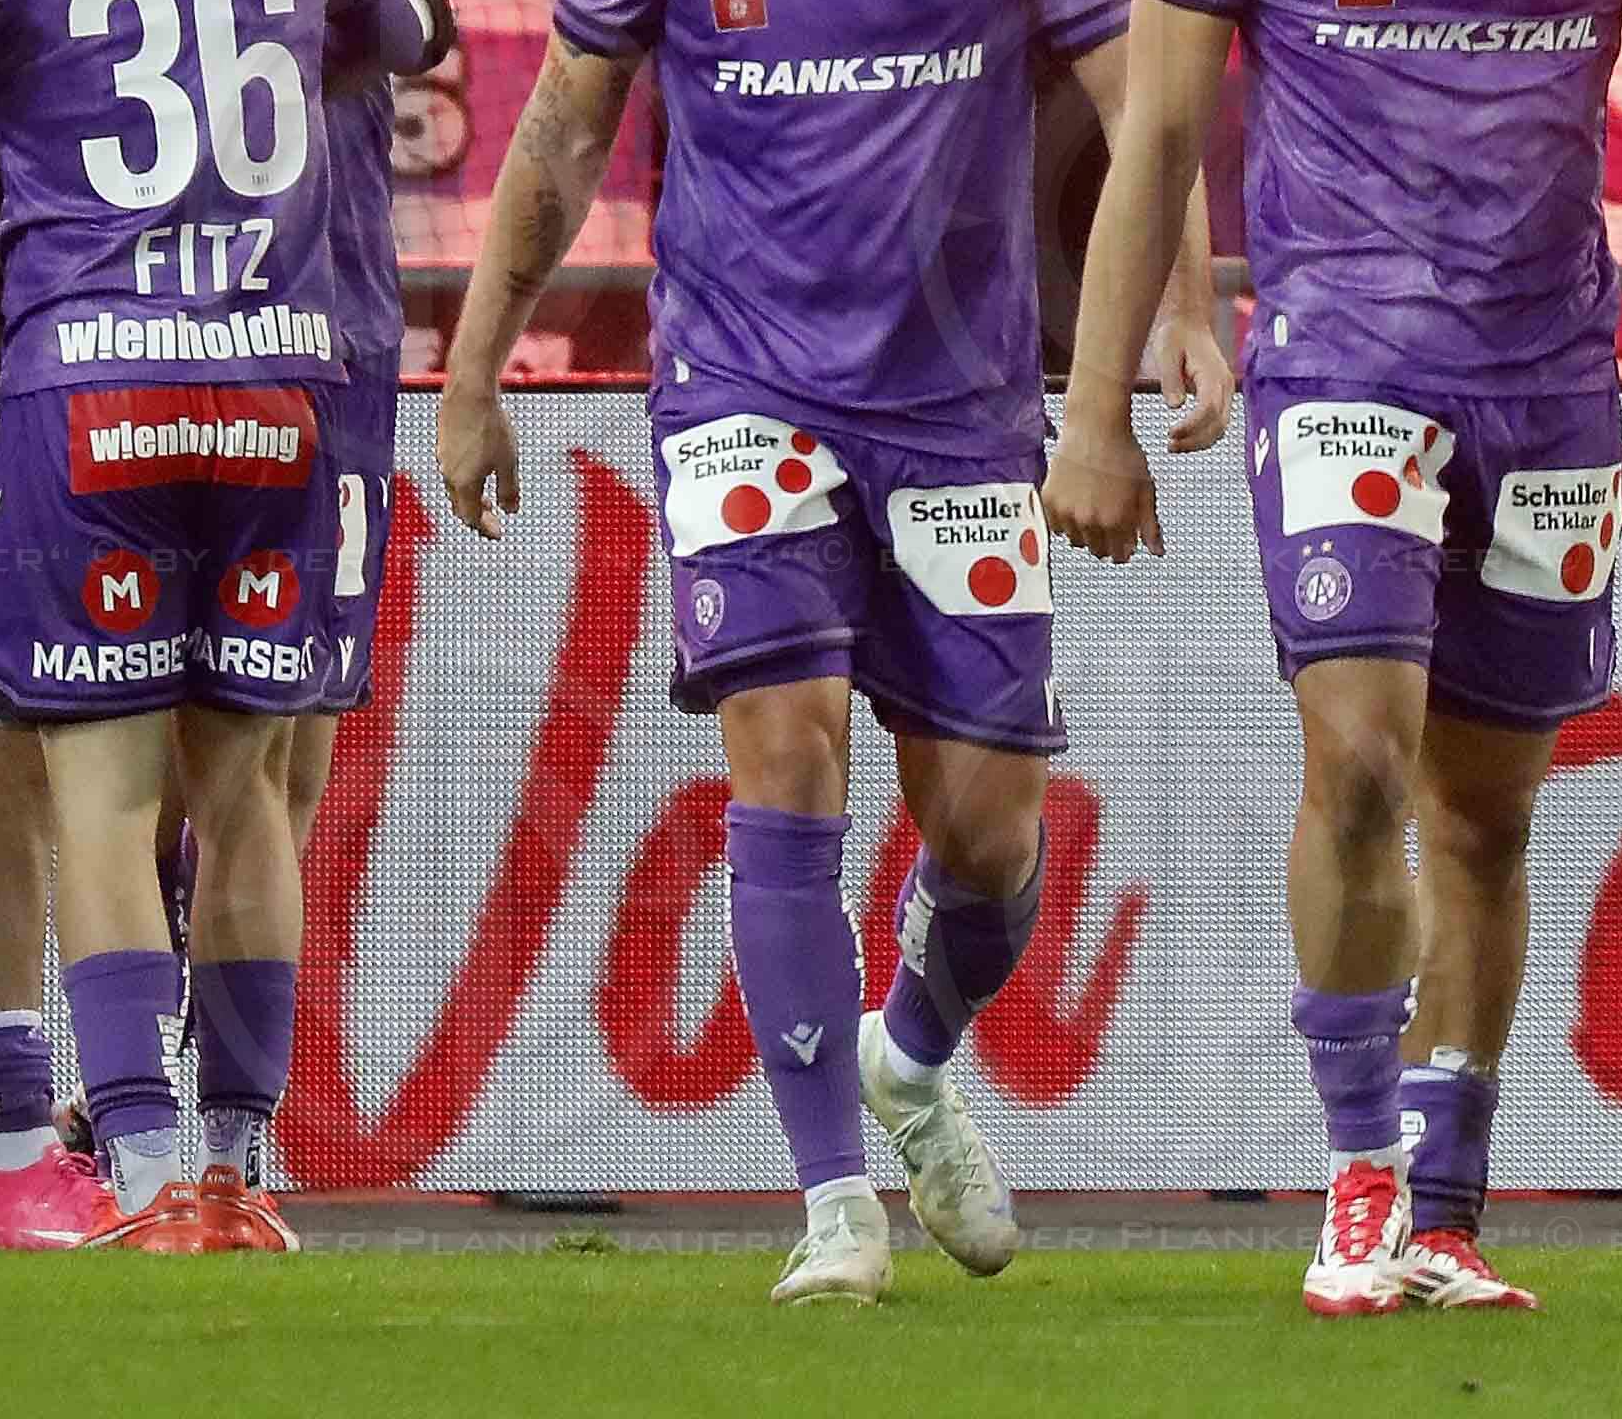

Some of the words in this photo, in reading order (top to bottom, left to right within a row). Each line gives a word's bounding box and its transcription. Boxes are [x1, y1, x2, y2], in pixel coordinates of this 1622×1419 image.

[133, 219, 276, 296] FITZ
[1295, 415, 1414, 443] Schuller
[677, 429, 780, 465] Schuller
[908, 495, 1022, 524] Schuller
